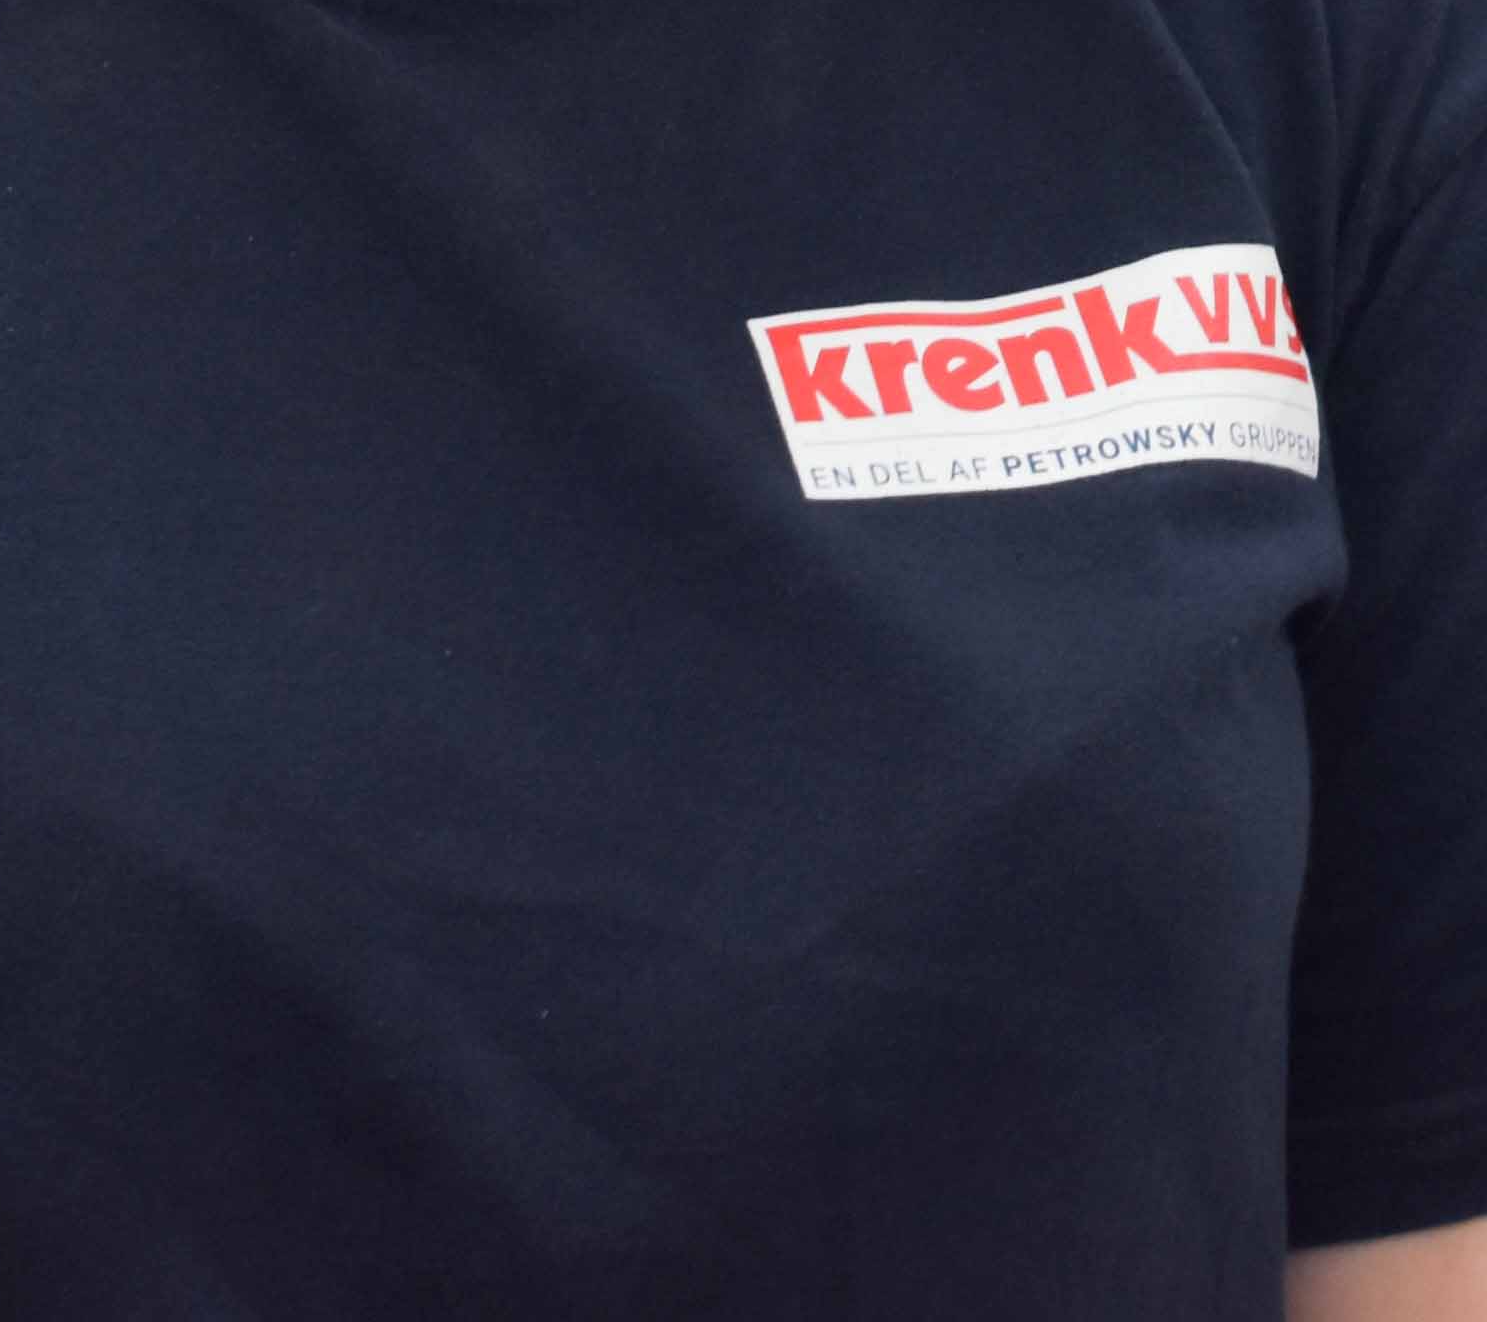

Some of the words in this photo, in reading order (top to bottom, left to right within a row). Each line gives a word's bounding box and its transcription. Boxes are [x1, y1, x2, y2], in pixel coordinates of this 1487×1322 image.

[810, 466, 857, 490] EN
[868, 459, 937, 487] DEL
[949, 456, 988, 481] AF
[1001, 422, 1216, 478] PETROWSKY
[1229, 422, 1316, 463] GRUPPEN
